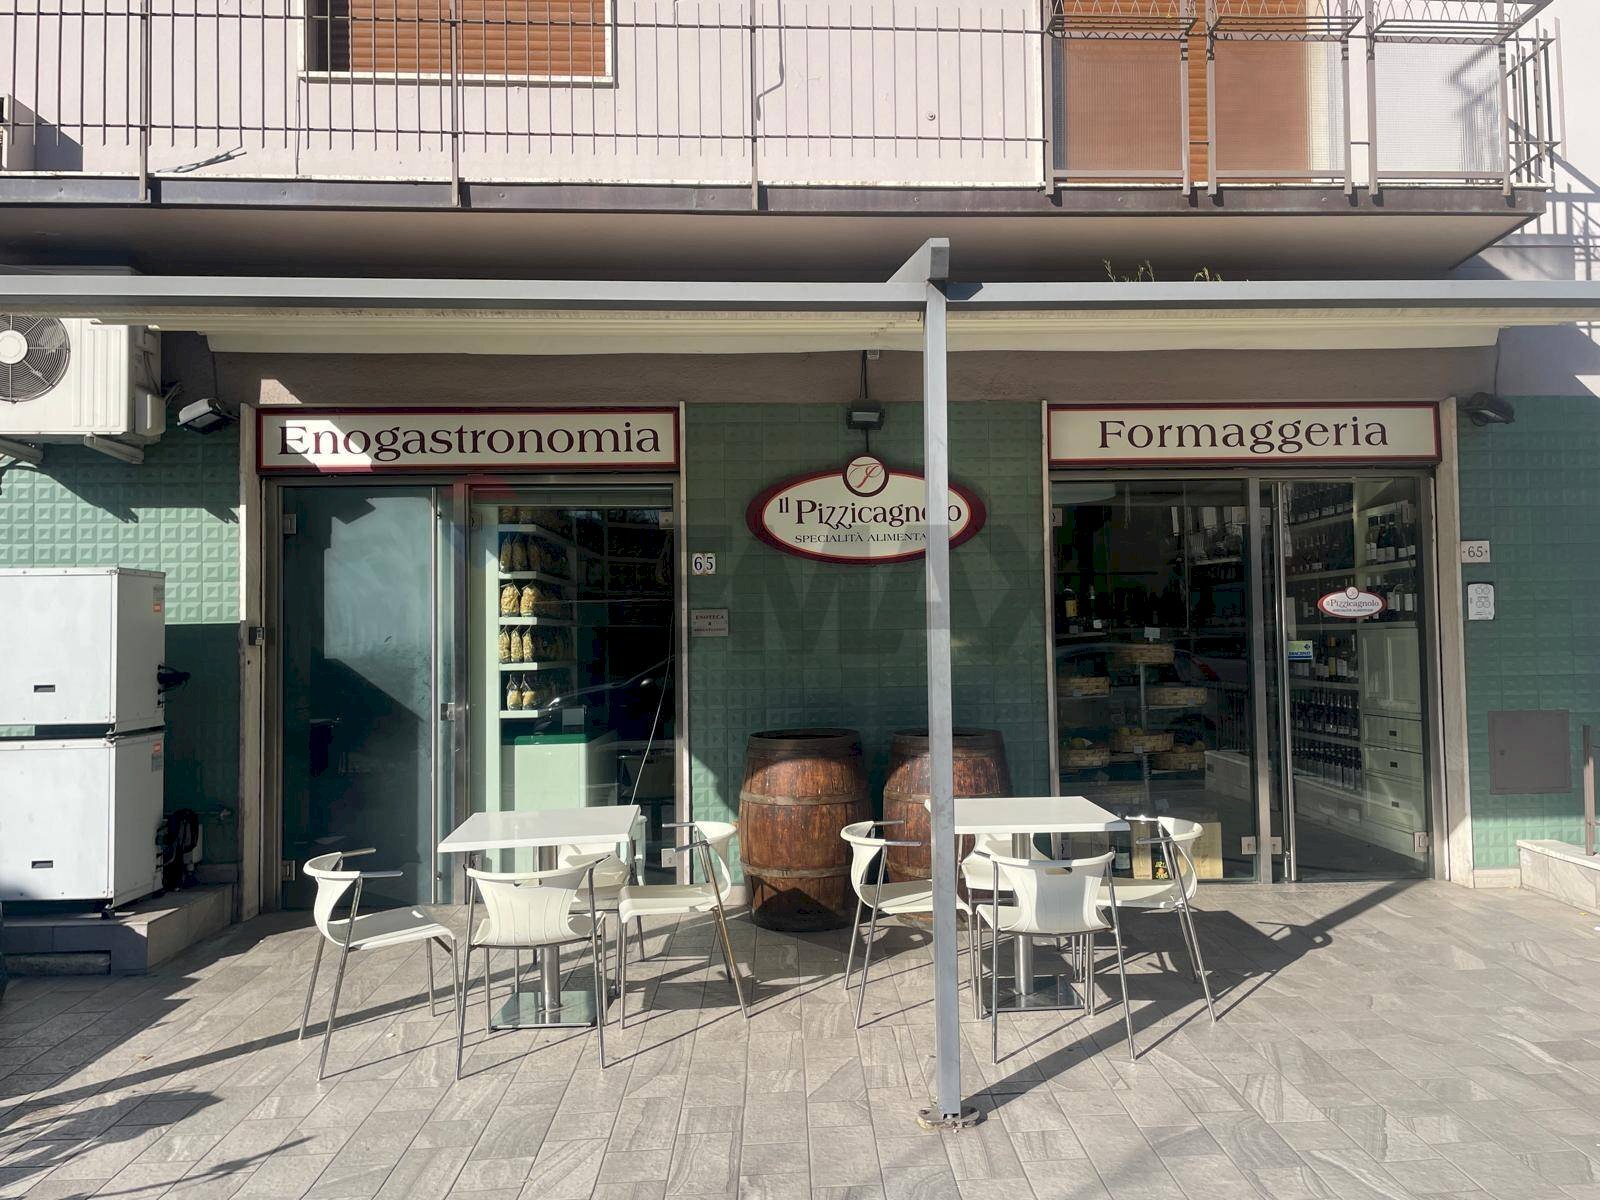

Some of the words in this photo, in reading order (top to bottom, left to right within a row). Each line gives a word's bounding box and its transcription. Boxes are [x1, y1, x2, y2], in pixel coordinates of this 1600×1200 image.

[278, 422, 661, 462] Enogastronomia
[1099, 417, 1389, 454] Formaggeria
[794, 498, 962, 530] Pizzicagno
[794, 532, 864, 544] SPECIALITÀ
[867, 532, 928, 543] ALIMENTA
[694, 556, 714, 571] 65
